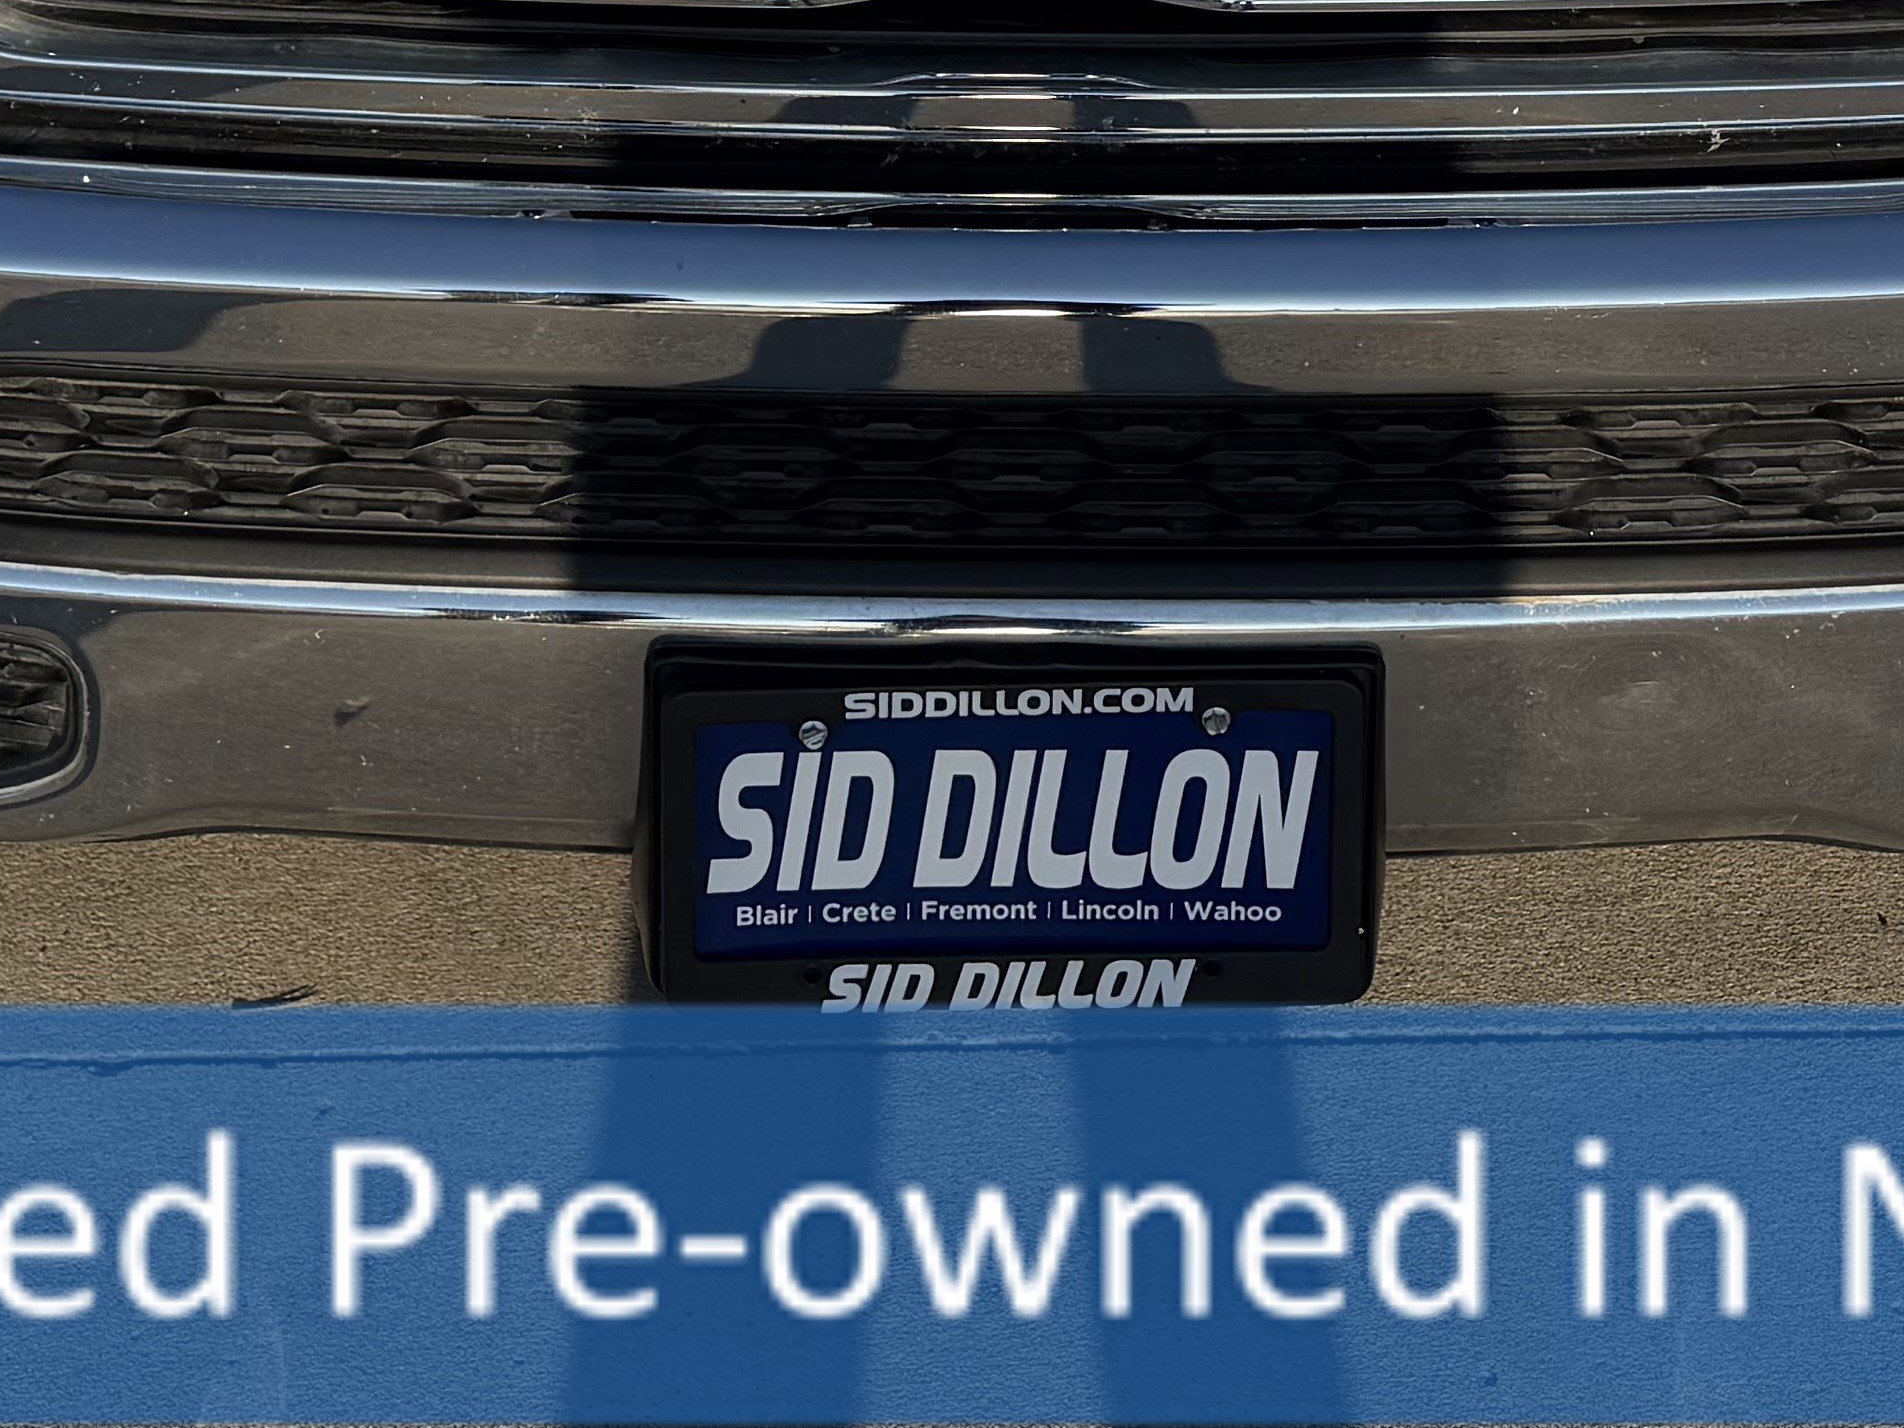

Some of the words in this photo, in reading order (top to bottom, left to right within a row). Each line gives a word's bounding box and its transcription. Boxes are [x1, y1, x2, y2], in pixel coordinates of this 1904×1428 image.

[844, 686, 1195, 721] SIDDILLON.COM
[706, 749, 897, 895] SID
[913, 748, 1320, 891] DILLON
[736, 901, 798, 928] Blair
[822, 899, 896, 925] Crete
[921, 899, 1037, 923] Fremont
[1061, 899, 1159, 923] Lincoln
[1183, 899, 1282, 925] Wahoo
[821, 960, 935, 1013] SID
[949, 957, 1197, 1010] DILLON
